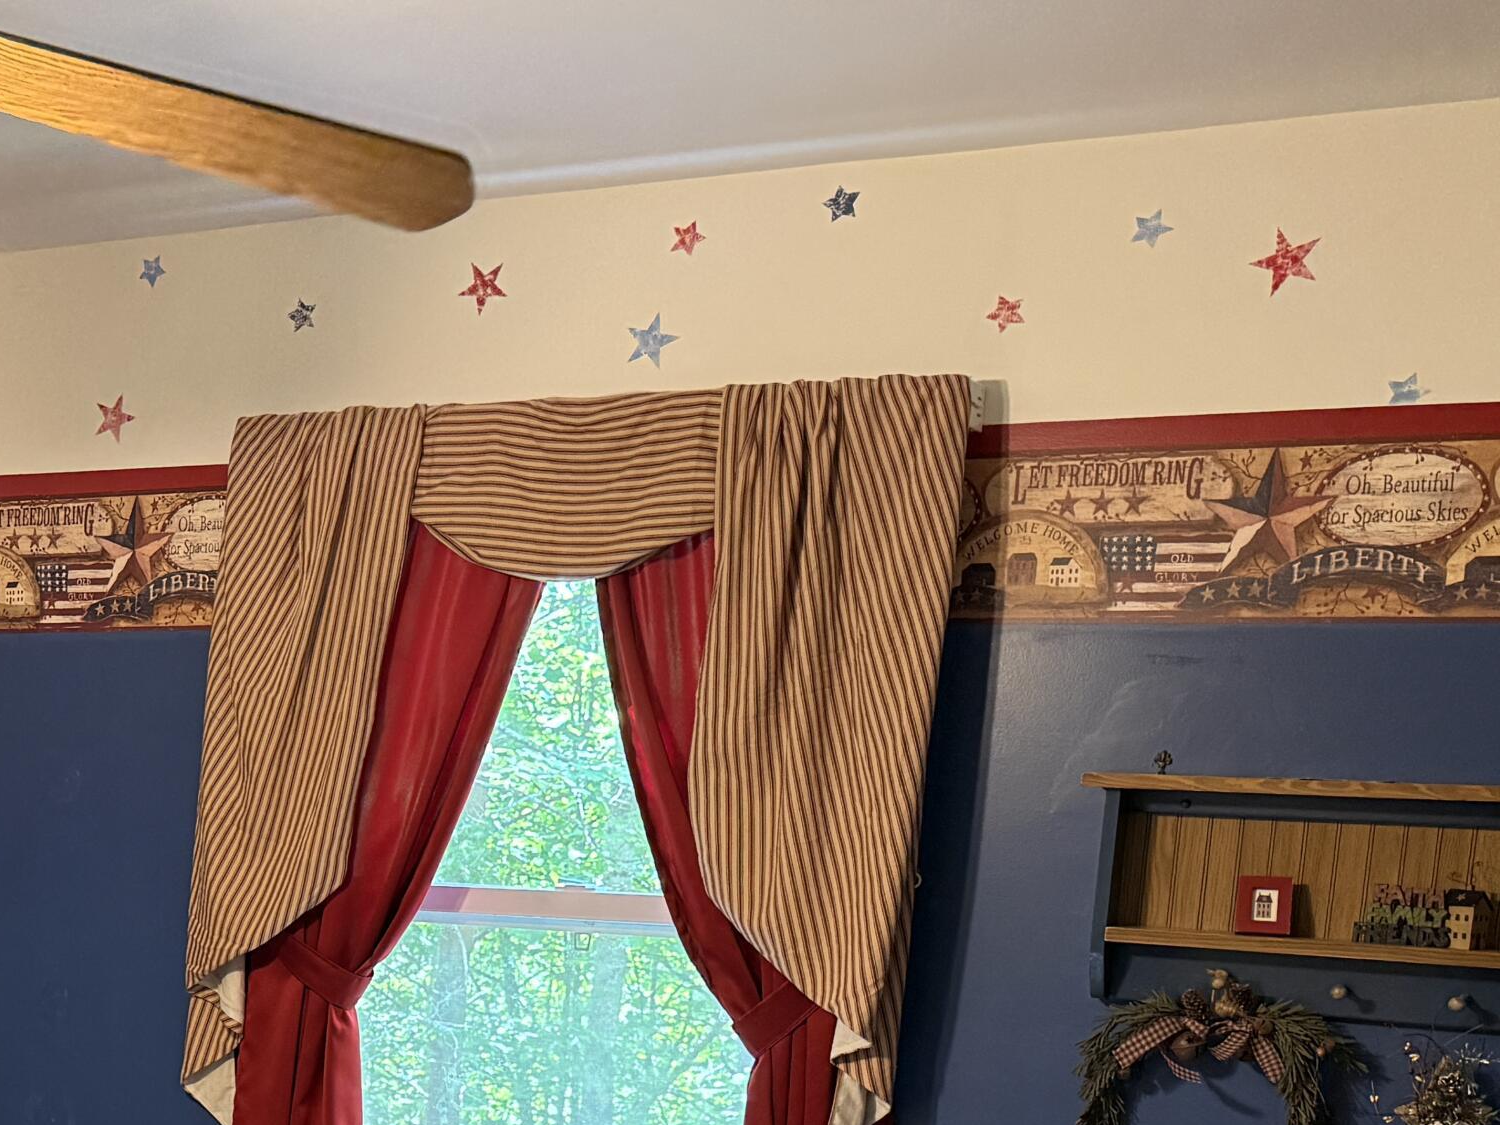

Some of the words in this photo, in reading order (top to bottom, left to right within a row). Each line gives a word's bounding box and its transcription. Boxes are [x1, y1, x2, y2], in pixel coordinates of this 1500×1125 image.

[1011, 462, 1053, 505] LET
[1056, 459, 1150, 488] FREEDOM
[1152, 457, 1204, 500] RING
[1345, 474, 1376, 496] Oh,
[1382, 470, 1455, 494] Beautiful
[6, 505, 64, 528] FREEDOM
[63, 503, 95, 537] RING
[178, 515, 197, 533] Oh,
[1325, 504, 1349, 525] for
[1352, 502, 1422, 531] Spacious
[1426, 500, 1469, 522] Skies
[184, 539, 221, 560] Spaciou
[964, 521, 1040, 561] WELCOME
[1043, 525, 1079, 556] HOME
[0, 558, 24, 581] HOME
[1170, 554, 1195, 564] OLD
[1290, 547, 1432, 585] LIBERTY
[149, 572, 218, 602] LIBERT
[1155, 572, 1198, 583] GLORY
[67, 592, 94, 601] GLORY
[1373, 883, 1446, 909] FAITH
[1352, 921, 1452, 948] FRIENDS
